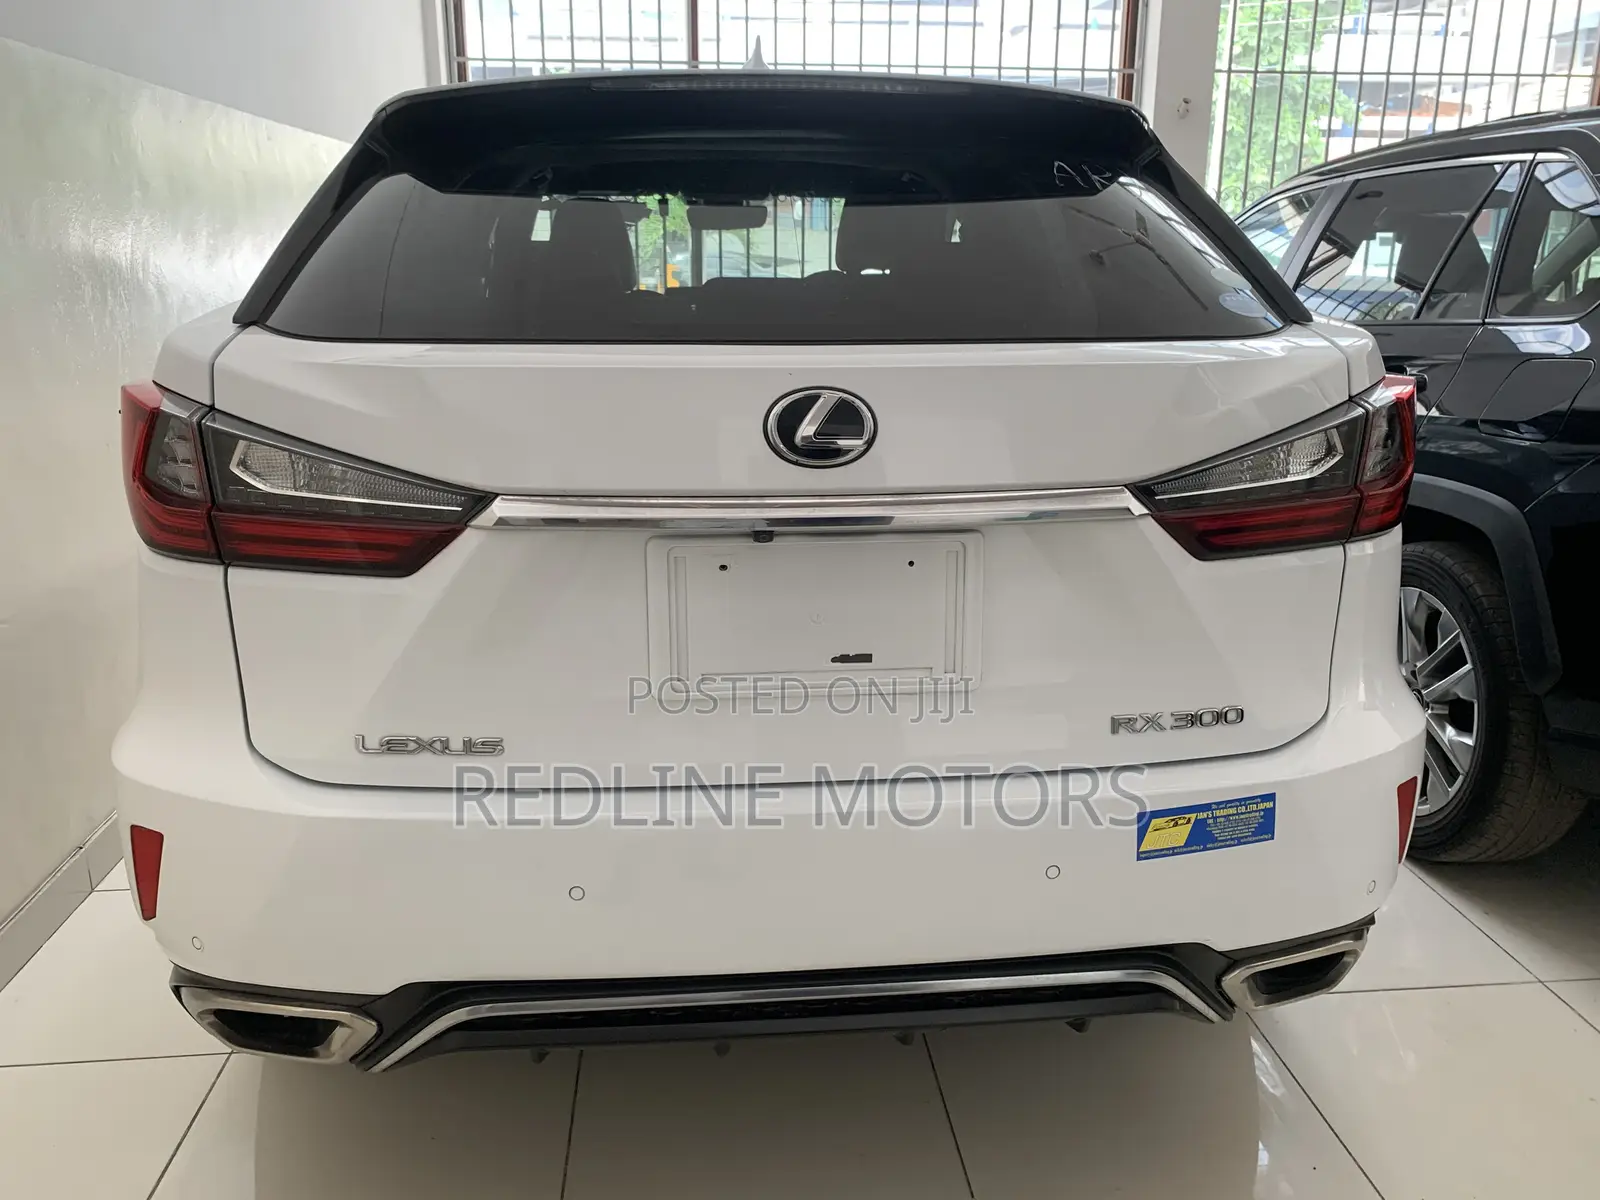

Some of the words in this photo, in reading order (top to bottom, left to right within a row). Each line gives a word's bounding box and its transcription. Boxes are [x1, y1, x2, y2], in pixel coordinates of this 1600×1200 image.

[1110, 712, 1167, 735] RX
[1169, 705, 1244, 730] 300
[354, 734, 505, 756] LEXUS
[1213, 807, 1237, 818] TRADING
